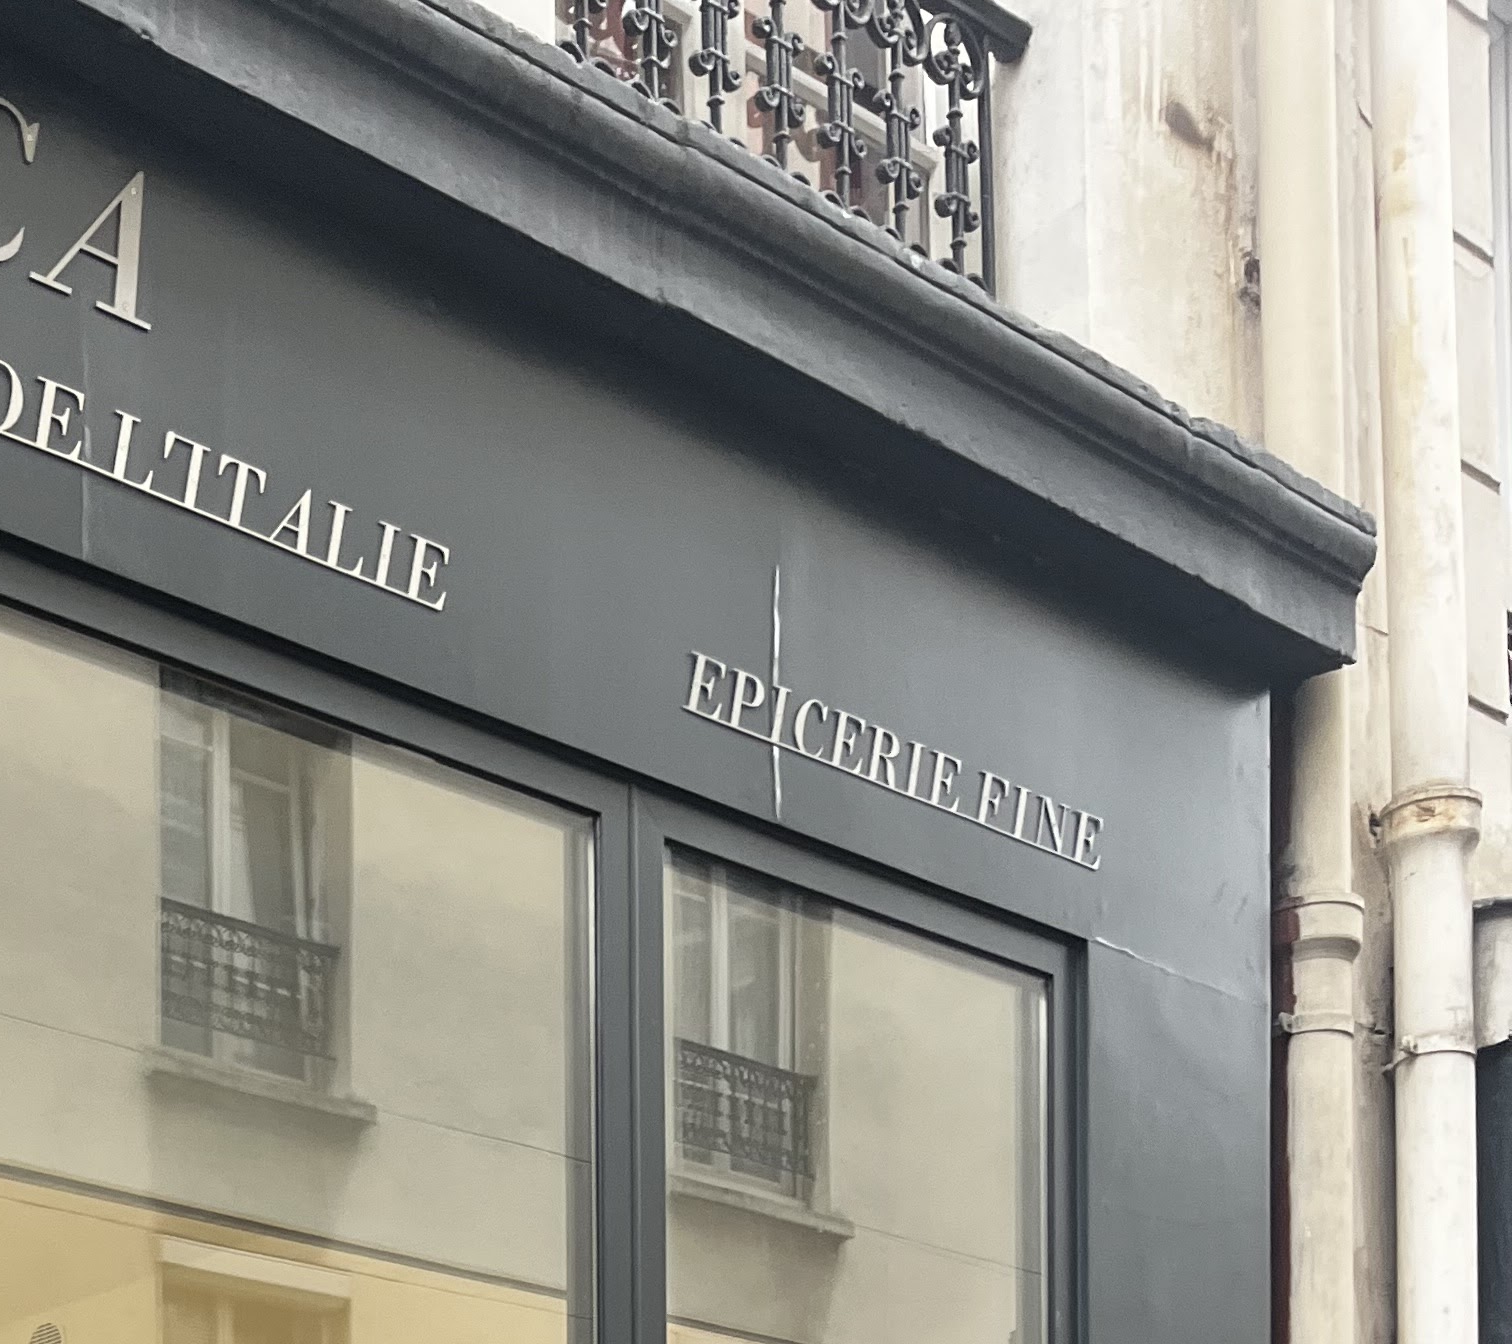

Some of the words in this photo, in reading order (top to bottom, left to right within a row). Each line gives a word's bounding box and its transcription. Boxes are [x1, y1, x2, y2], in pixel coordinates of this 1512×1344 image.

[113, 409, 450, 611] L'ITALIE
[682, 651, 963, 814] EPICERIE
[977, 769, 1105, 871] FINE
